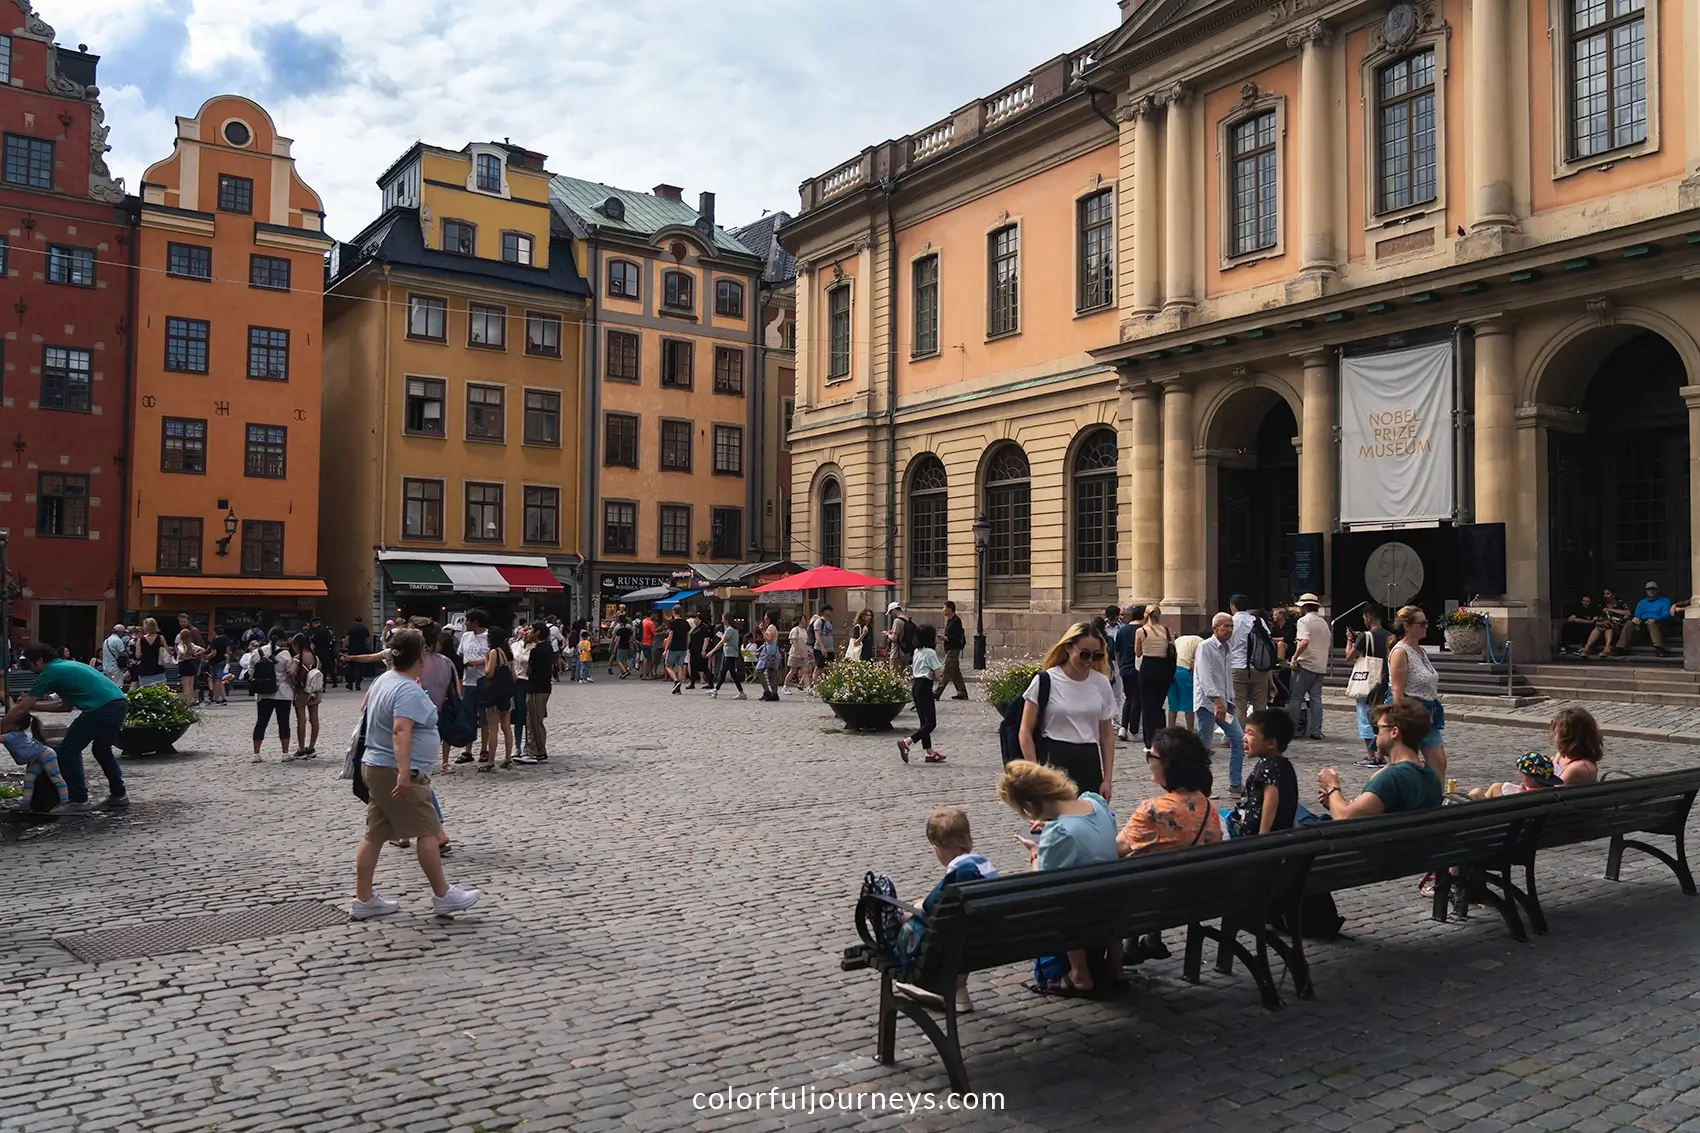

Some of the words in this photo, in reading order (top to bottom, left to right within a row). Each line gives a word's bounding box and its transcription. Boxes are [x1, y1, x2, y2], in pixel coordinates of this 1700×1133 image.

[1369, 408, 1421, 426] NOBEL
[1374, 425, 1417, 441] PRIZE
[1358, 439, 1432, 458] MUSEUM
